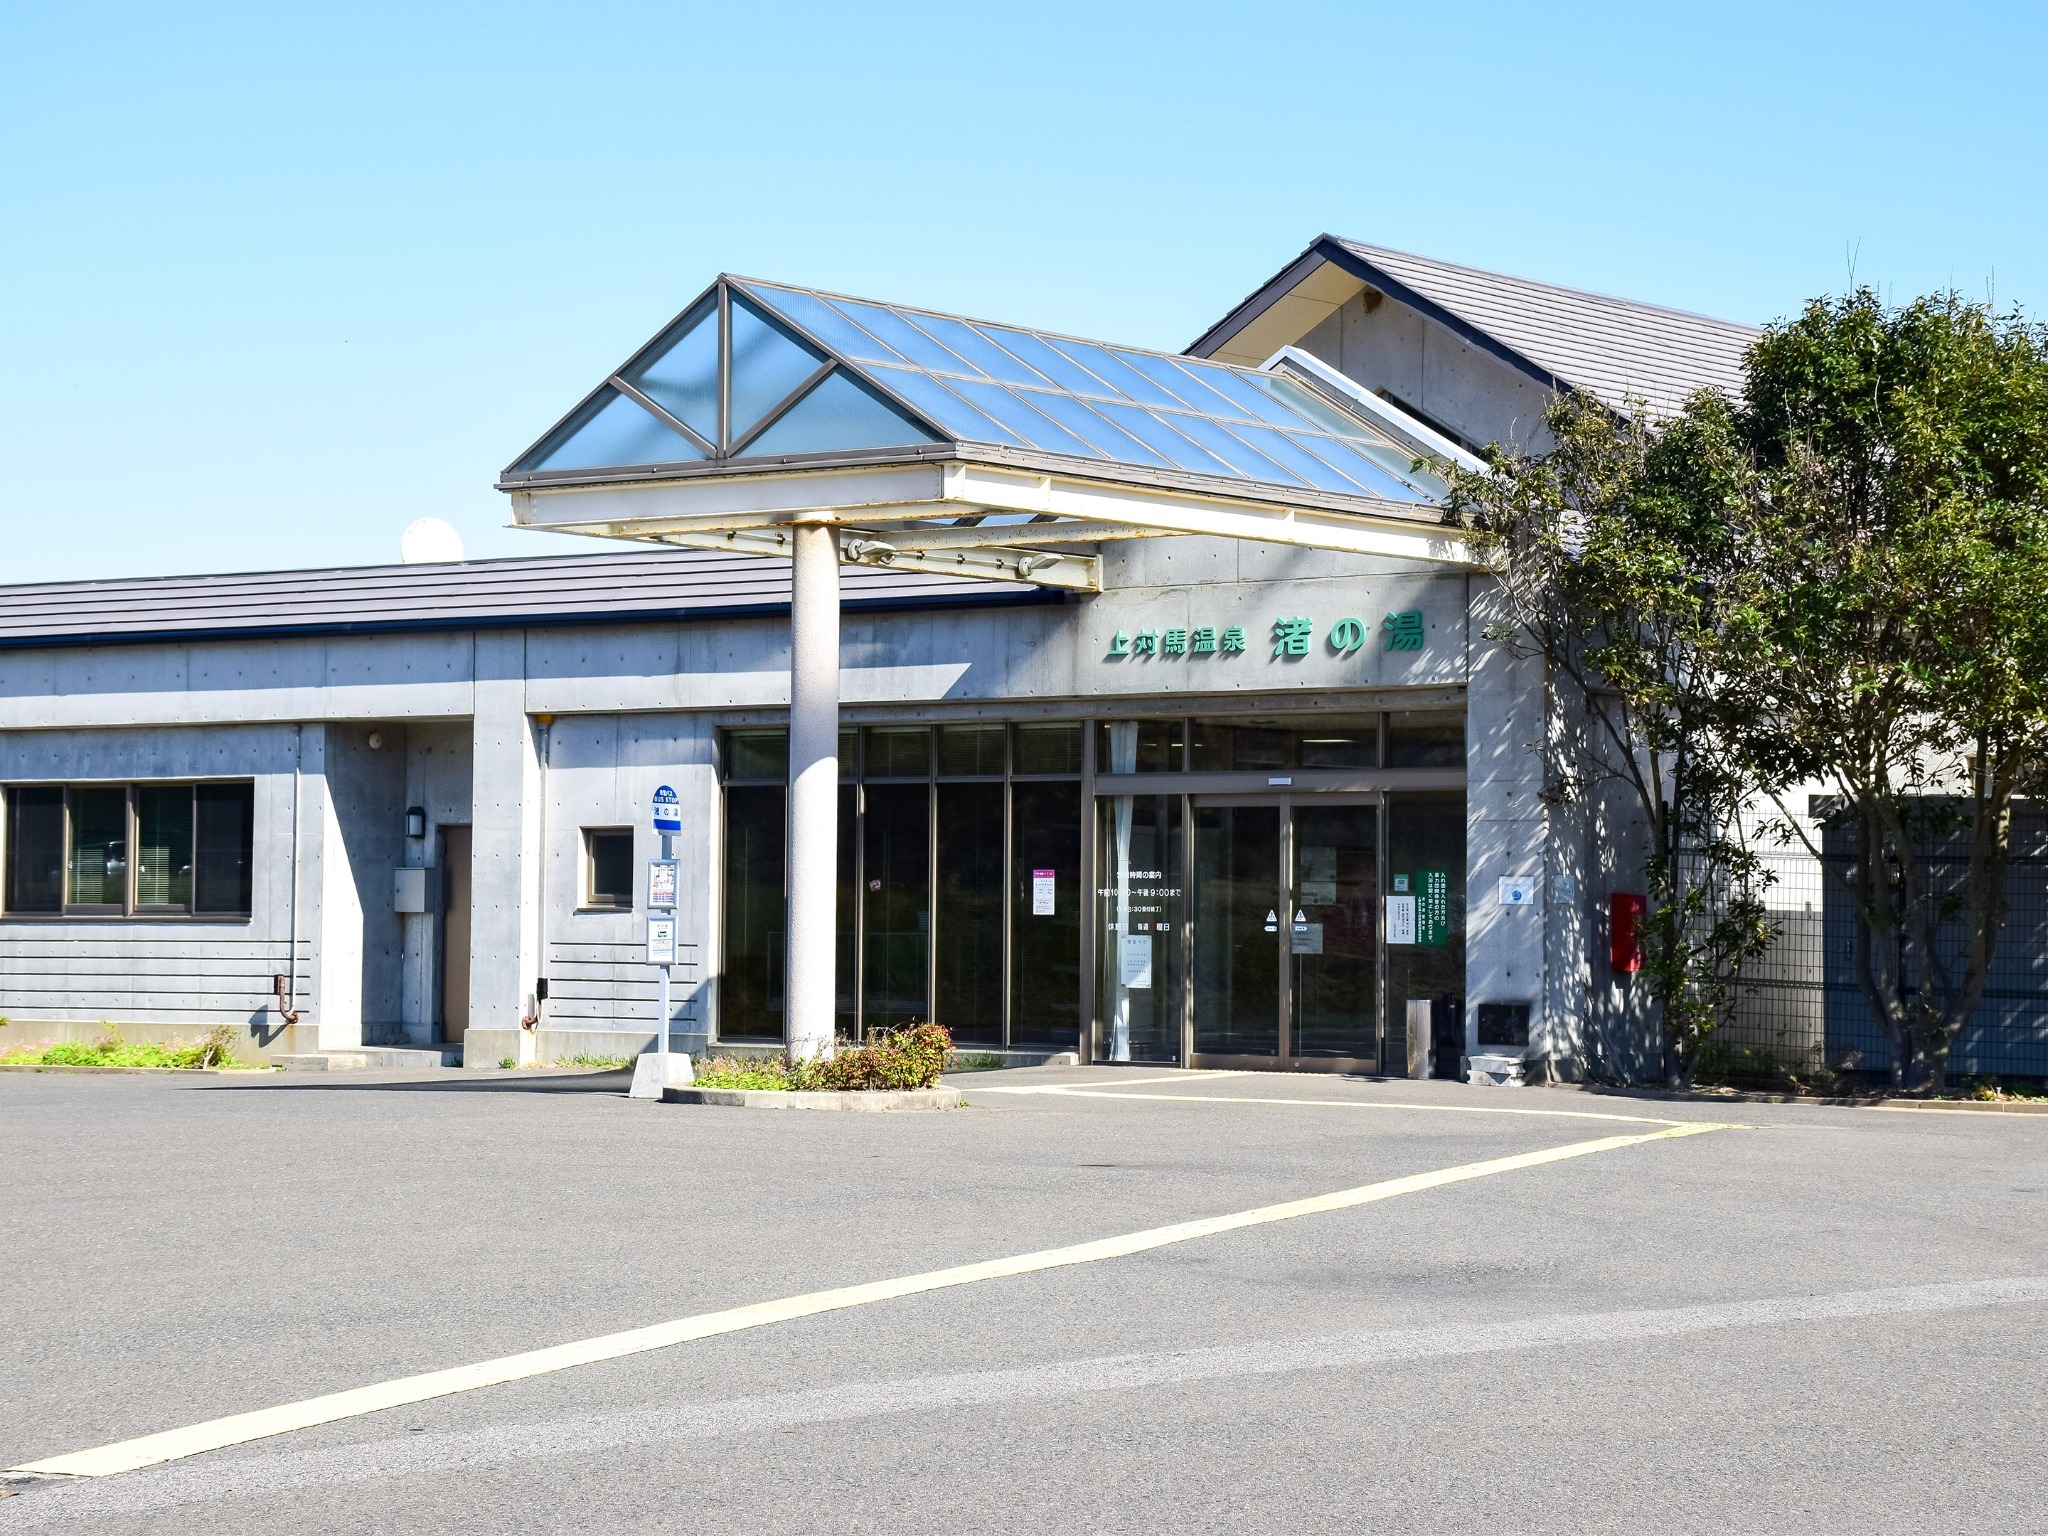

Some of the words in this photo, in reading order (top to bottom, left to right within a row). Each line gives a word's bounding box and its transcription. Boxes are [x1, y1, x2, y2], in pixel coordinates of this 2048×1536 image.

[1107, 625, 1246, 656] 上対馬温泉
[1274, 610, 1425, 657] 渚の湯
